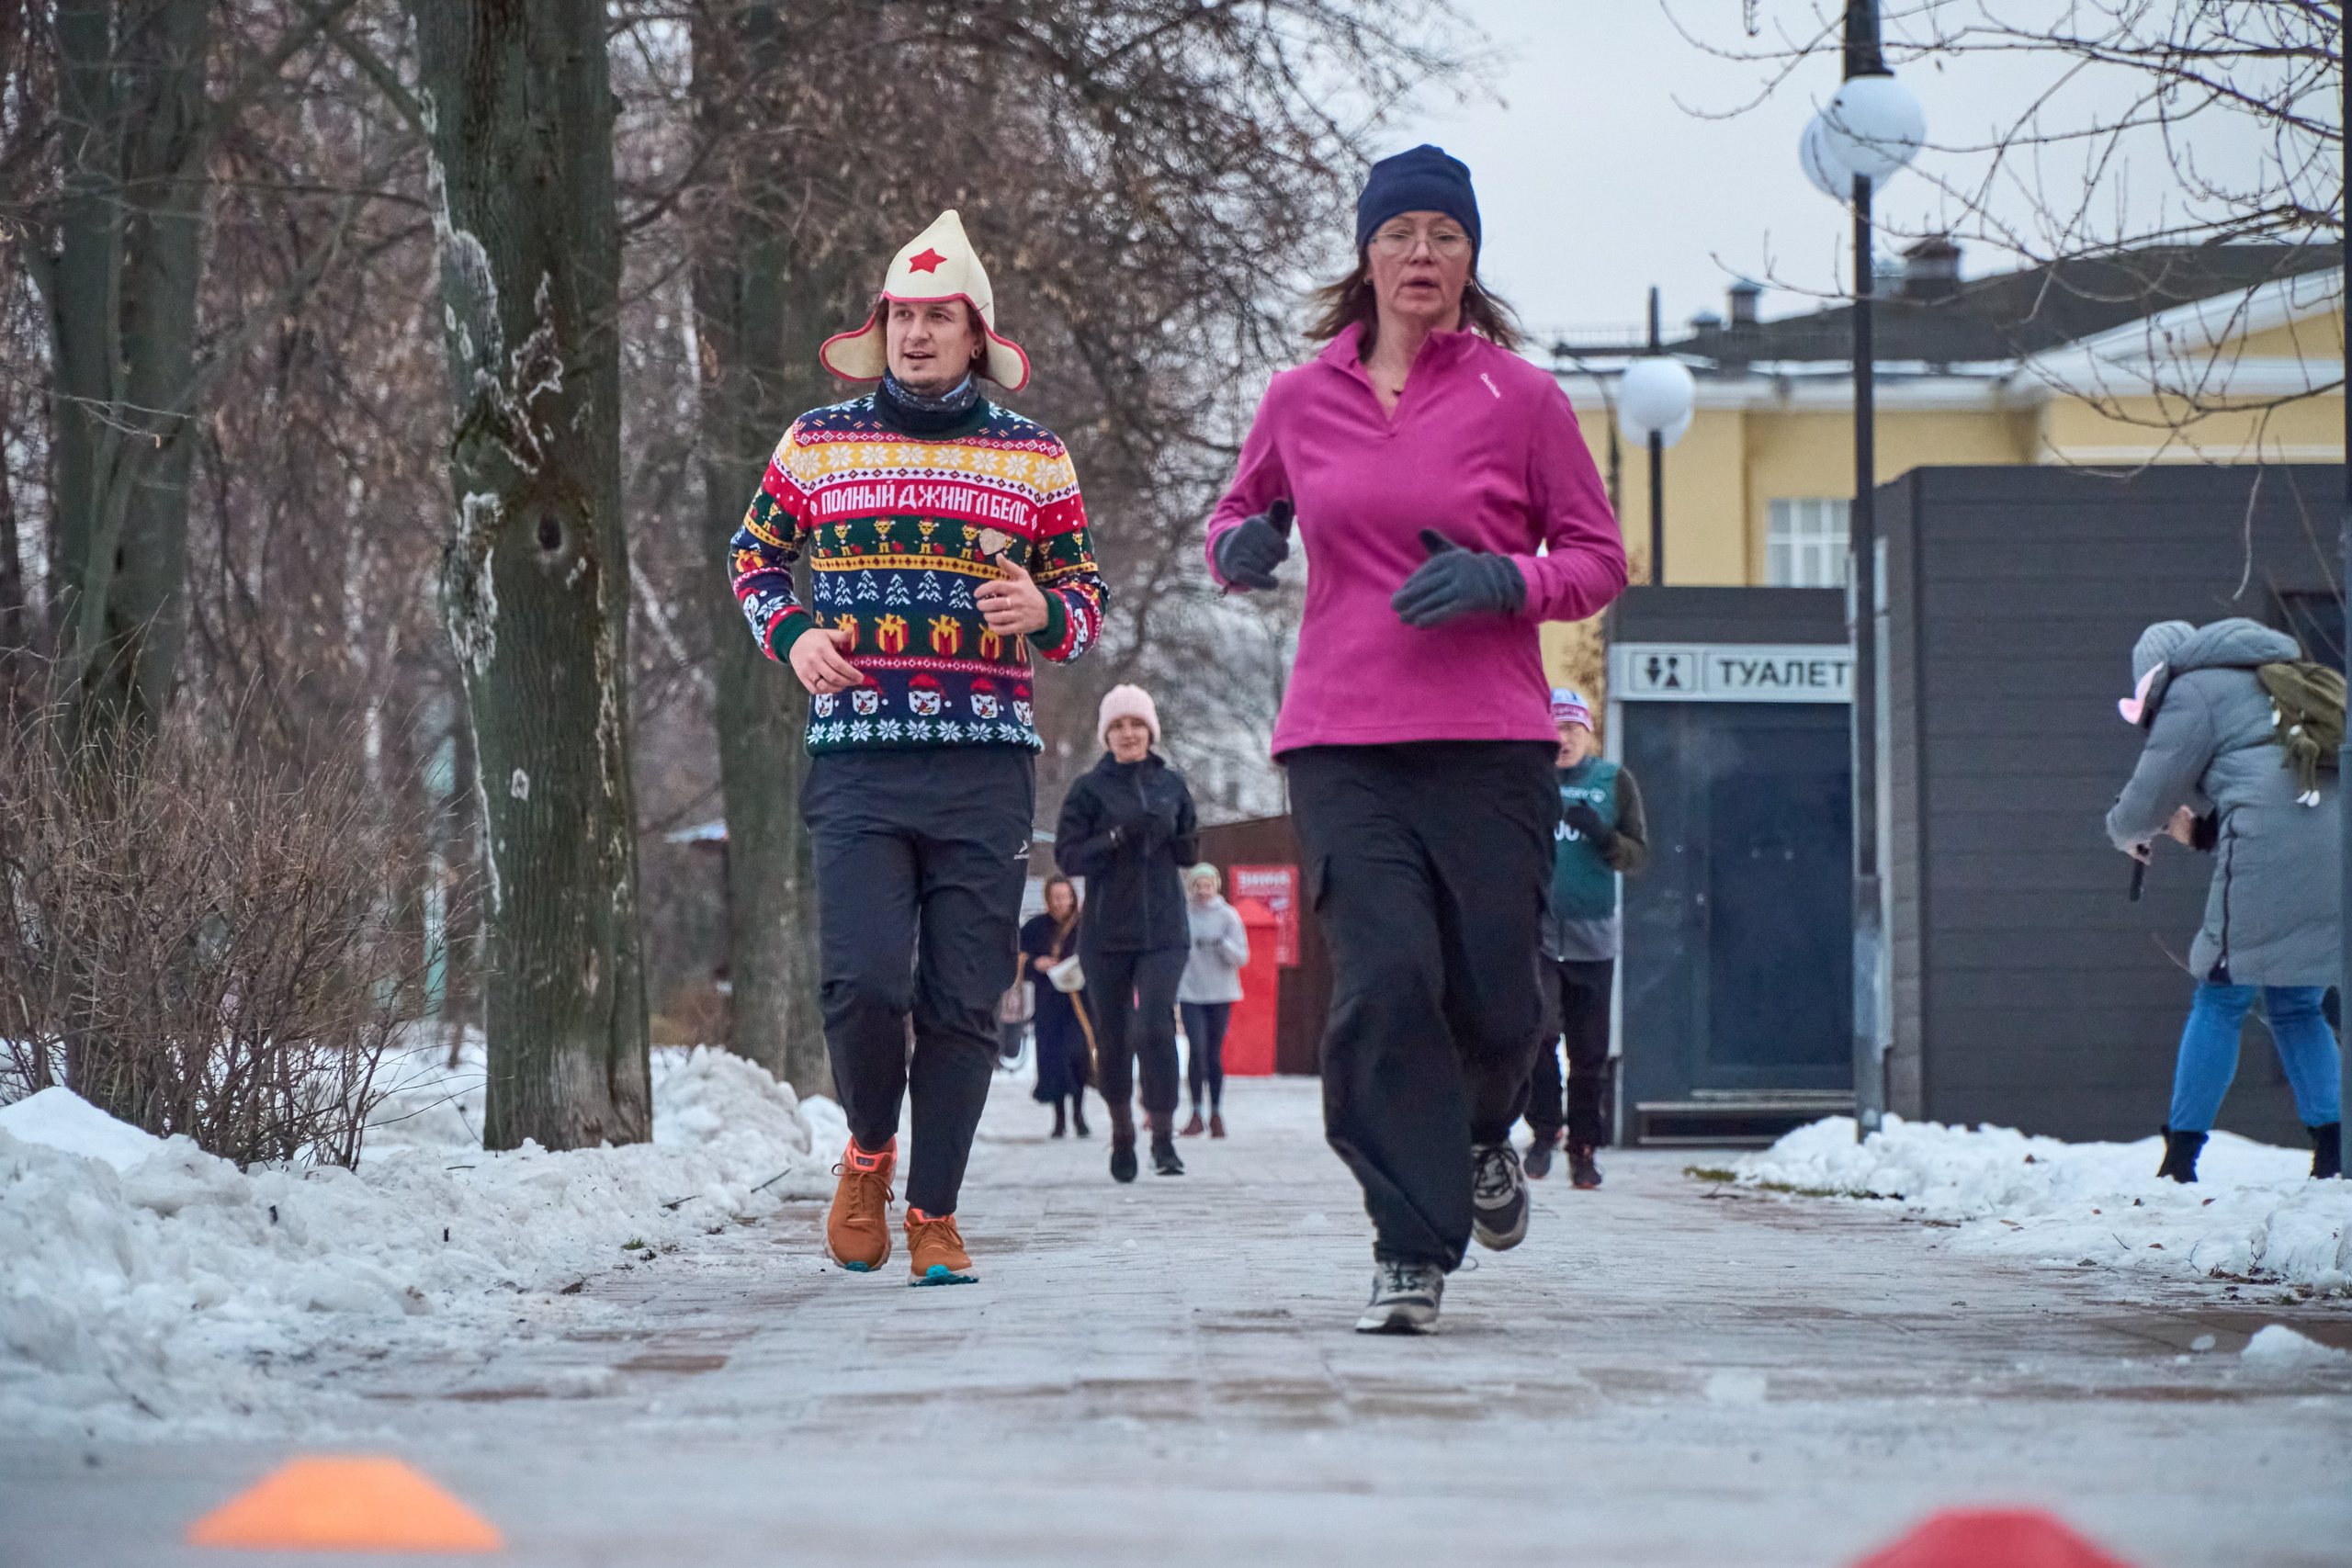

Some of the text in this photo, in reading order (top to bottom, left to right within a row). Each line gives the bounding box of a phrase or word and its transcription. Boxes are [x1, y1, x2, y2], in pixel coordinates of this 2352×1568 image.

[821, 479, 1029, 527] ПОЛНЫЙ ДЖИНГЛ БЕЛС
[1717, 660, 1849, 687] ТУАЛЕТ
